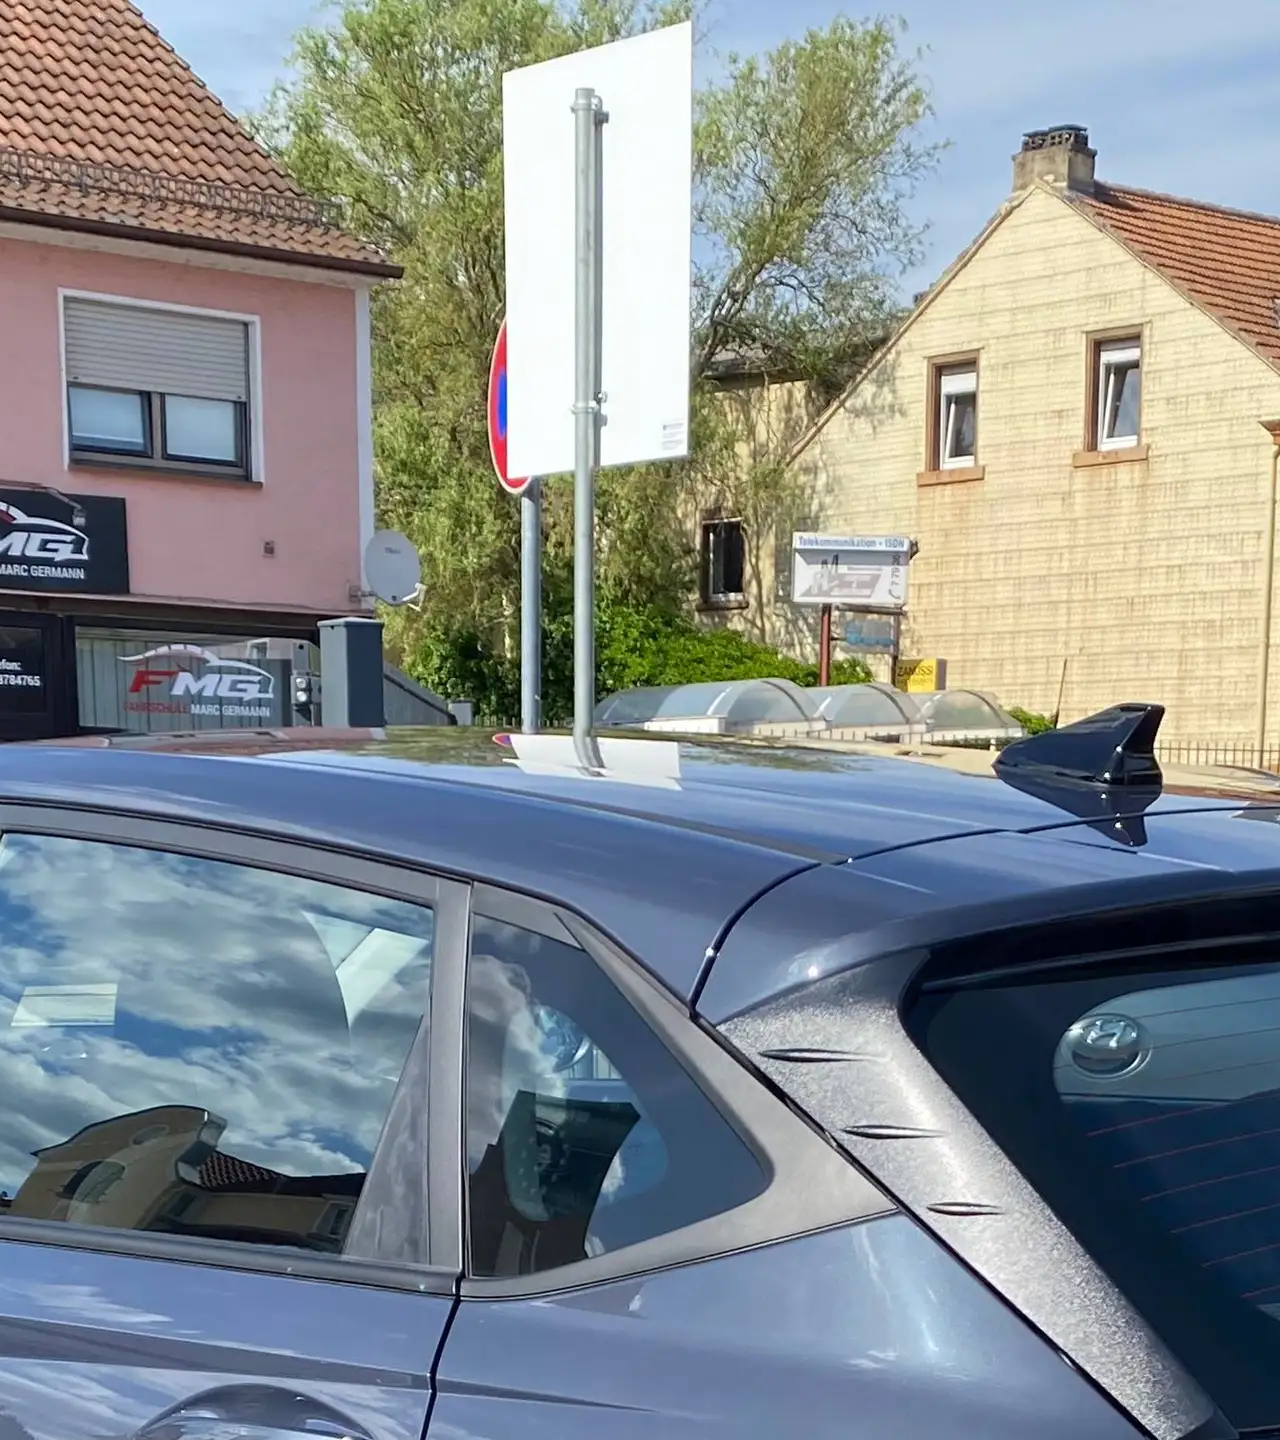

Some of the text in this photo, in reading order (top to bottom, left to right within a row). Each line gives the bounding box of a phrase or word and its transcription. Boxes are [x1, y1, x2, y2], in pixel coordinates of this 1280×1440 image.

[30, 566, 85, 580] GERMANN
[129, 671, 265, 699] FMG
[124, 701, 271, 718] FAHRSCHULE MARC GERMANN
